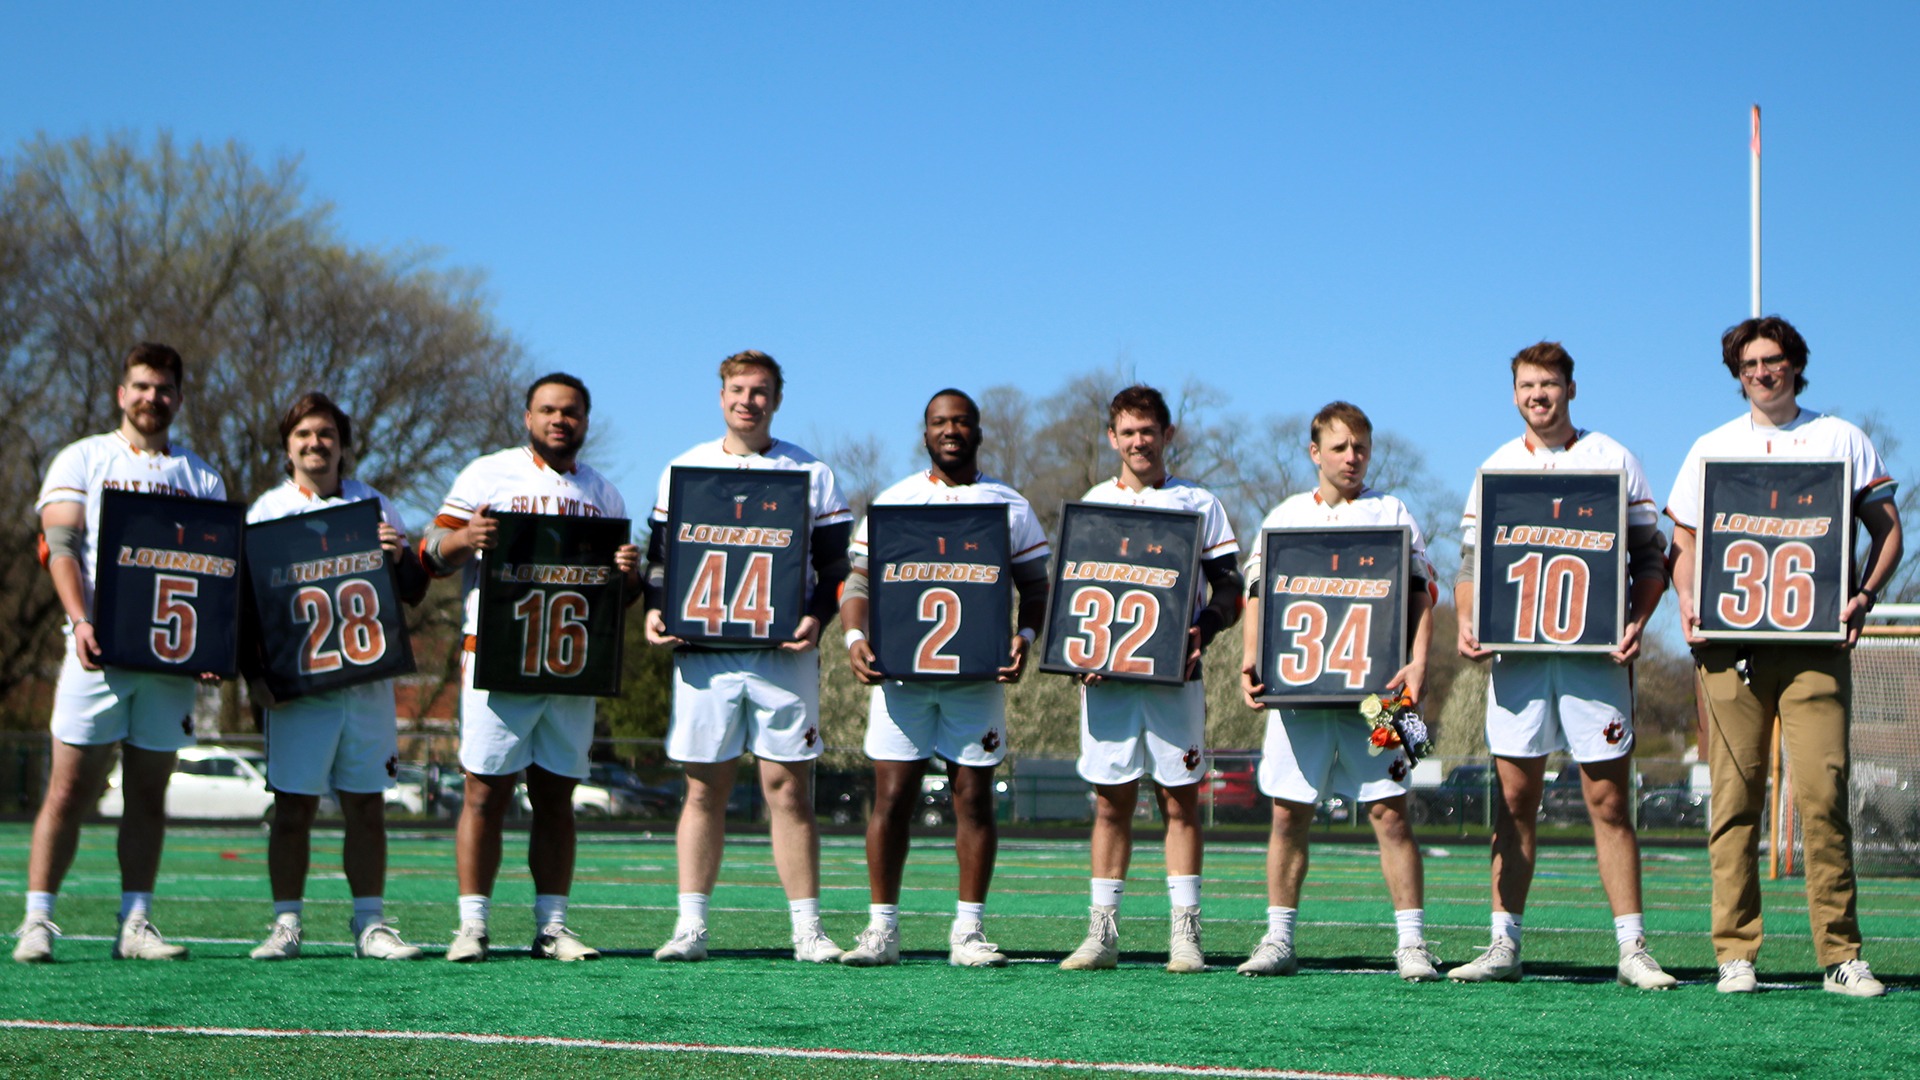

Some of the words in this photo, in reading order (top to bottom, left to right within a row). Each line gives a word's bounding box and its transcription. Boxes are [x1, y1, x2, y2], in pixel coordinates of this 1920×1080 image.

[678, 522, 794, 548] LOURDES
[1494, 524, 1616, 551] LOURDES
[1712, 512, 1832, 538] LOURDES
[118, 546, 237, 578] LOURDES
[271, 550, 384, 587] LOURDES
[501, 562, 612, 586] LOURDES
[882, 562, 1001, 584] LOURDES
[1062, 561, 1180, 589] LOURDES
[1274, 575, 1392, 599] LOURDES
[1716, 540, 1818, 632] 36
[149, 573, 199, 663] 5
[682, 551, 775, 639] 44
[1505, 552, 1591, 645] 10
[292, 579, 387, 675] 28
[513, 589, 590, 677] 16
[914, 588, 962, 675] 2
[1063, 586, 1161, 676] 32
[1276, 602, 1373, 690] 34
